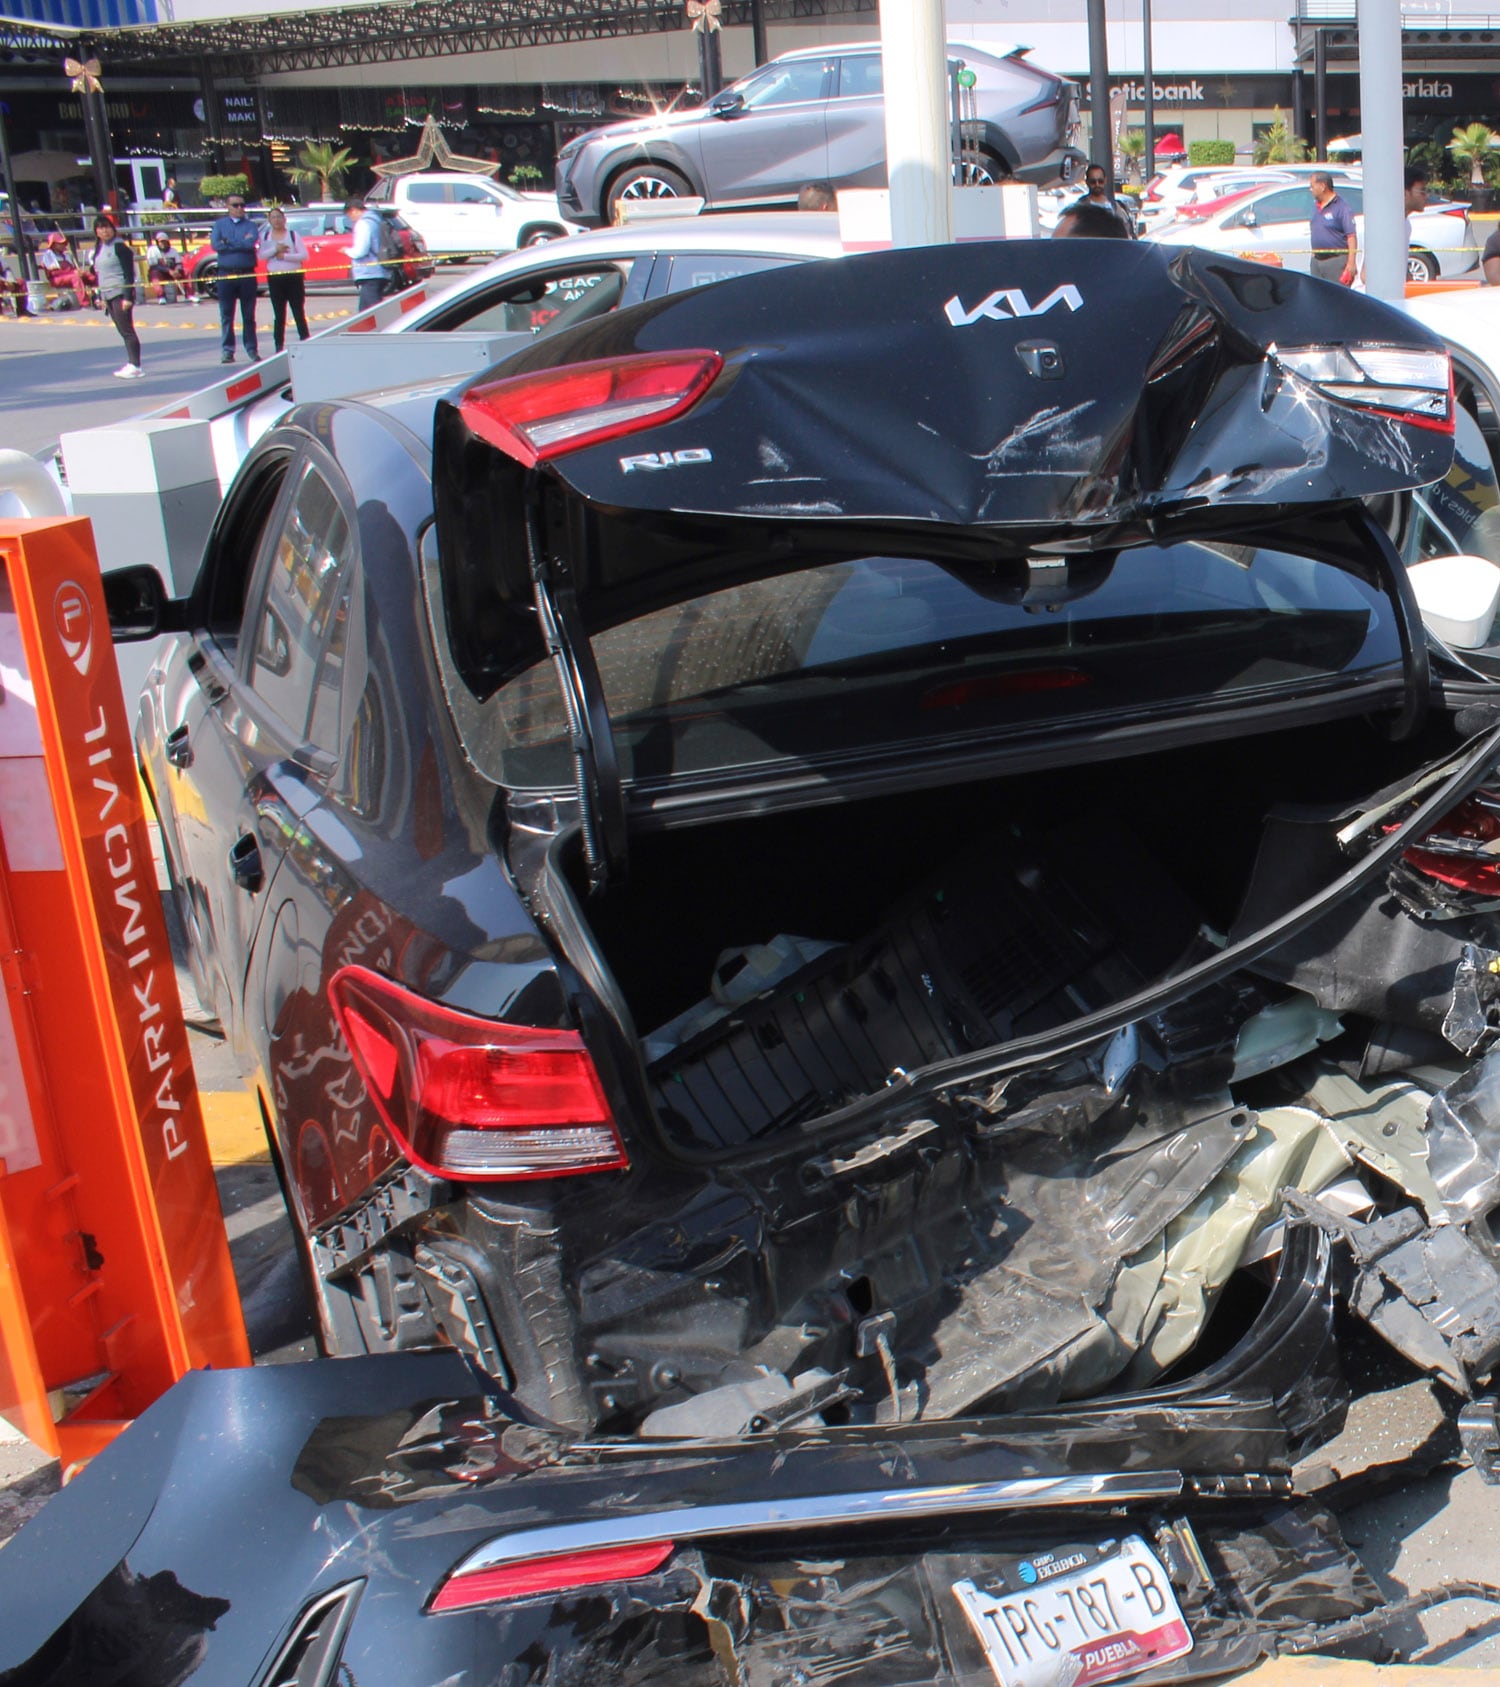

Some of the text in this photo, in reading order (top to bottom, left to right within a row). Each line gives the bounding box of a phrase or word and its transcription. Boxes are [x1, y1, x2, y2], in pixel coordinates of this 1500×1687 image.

[943, 283, 1084, 327] KIA
[618, 447, 713, 475] RIO
[84, 704, 190, 1162] PARKIMOVIL
[1037, 1552, 1088, 1580] EXCELENCIA
[983, 1561, 1167, 1668] TPG-787-B
[1085, 1639, 1141, 1670] PUEBLA
